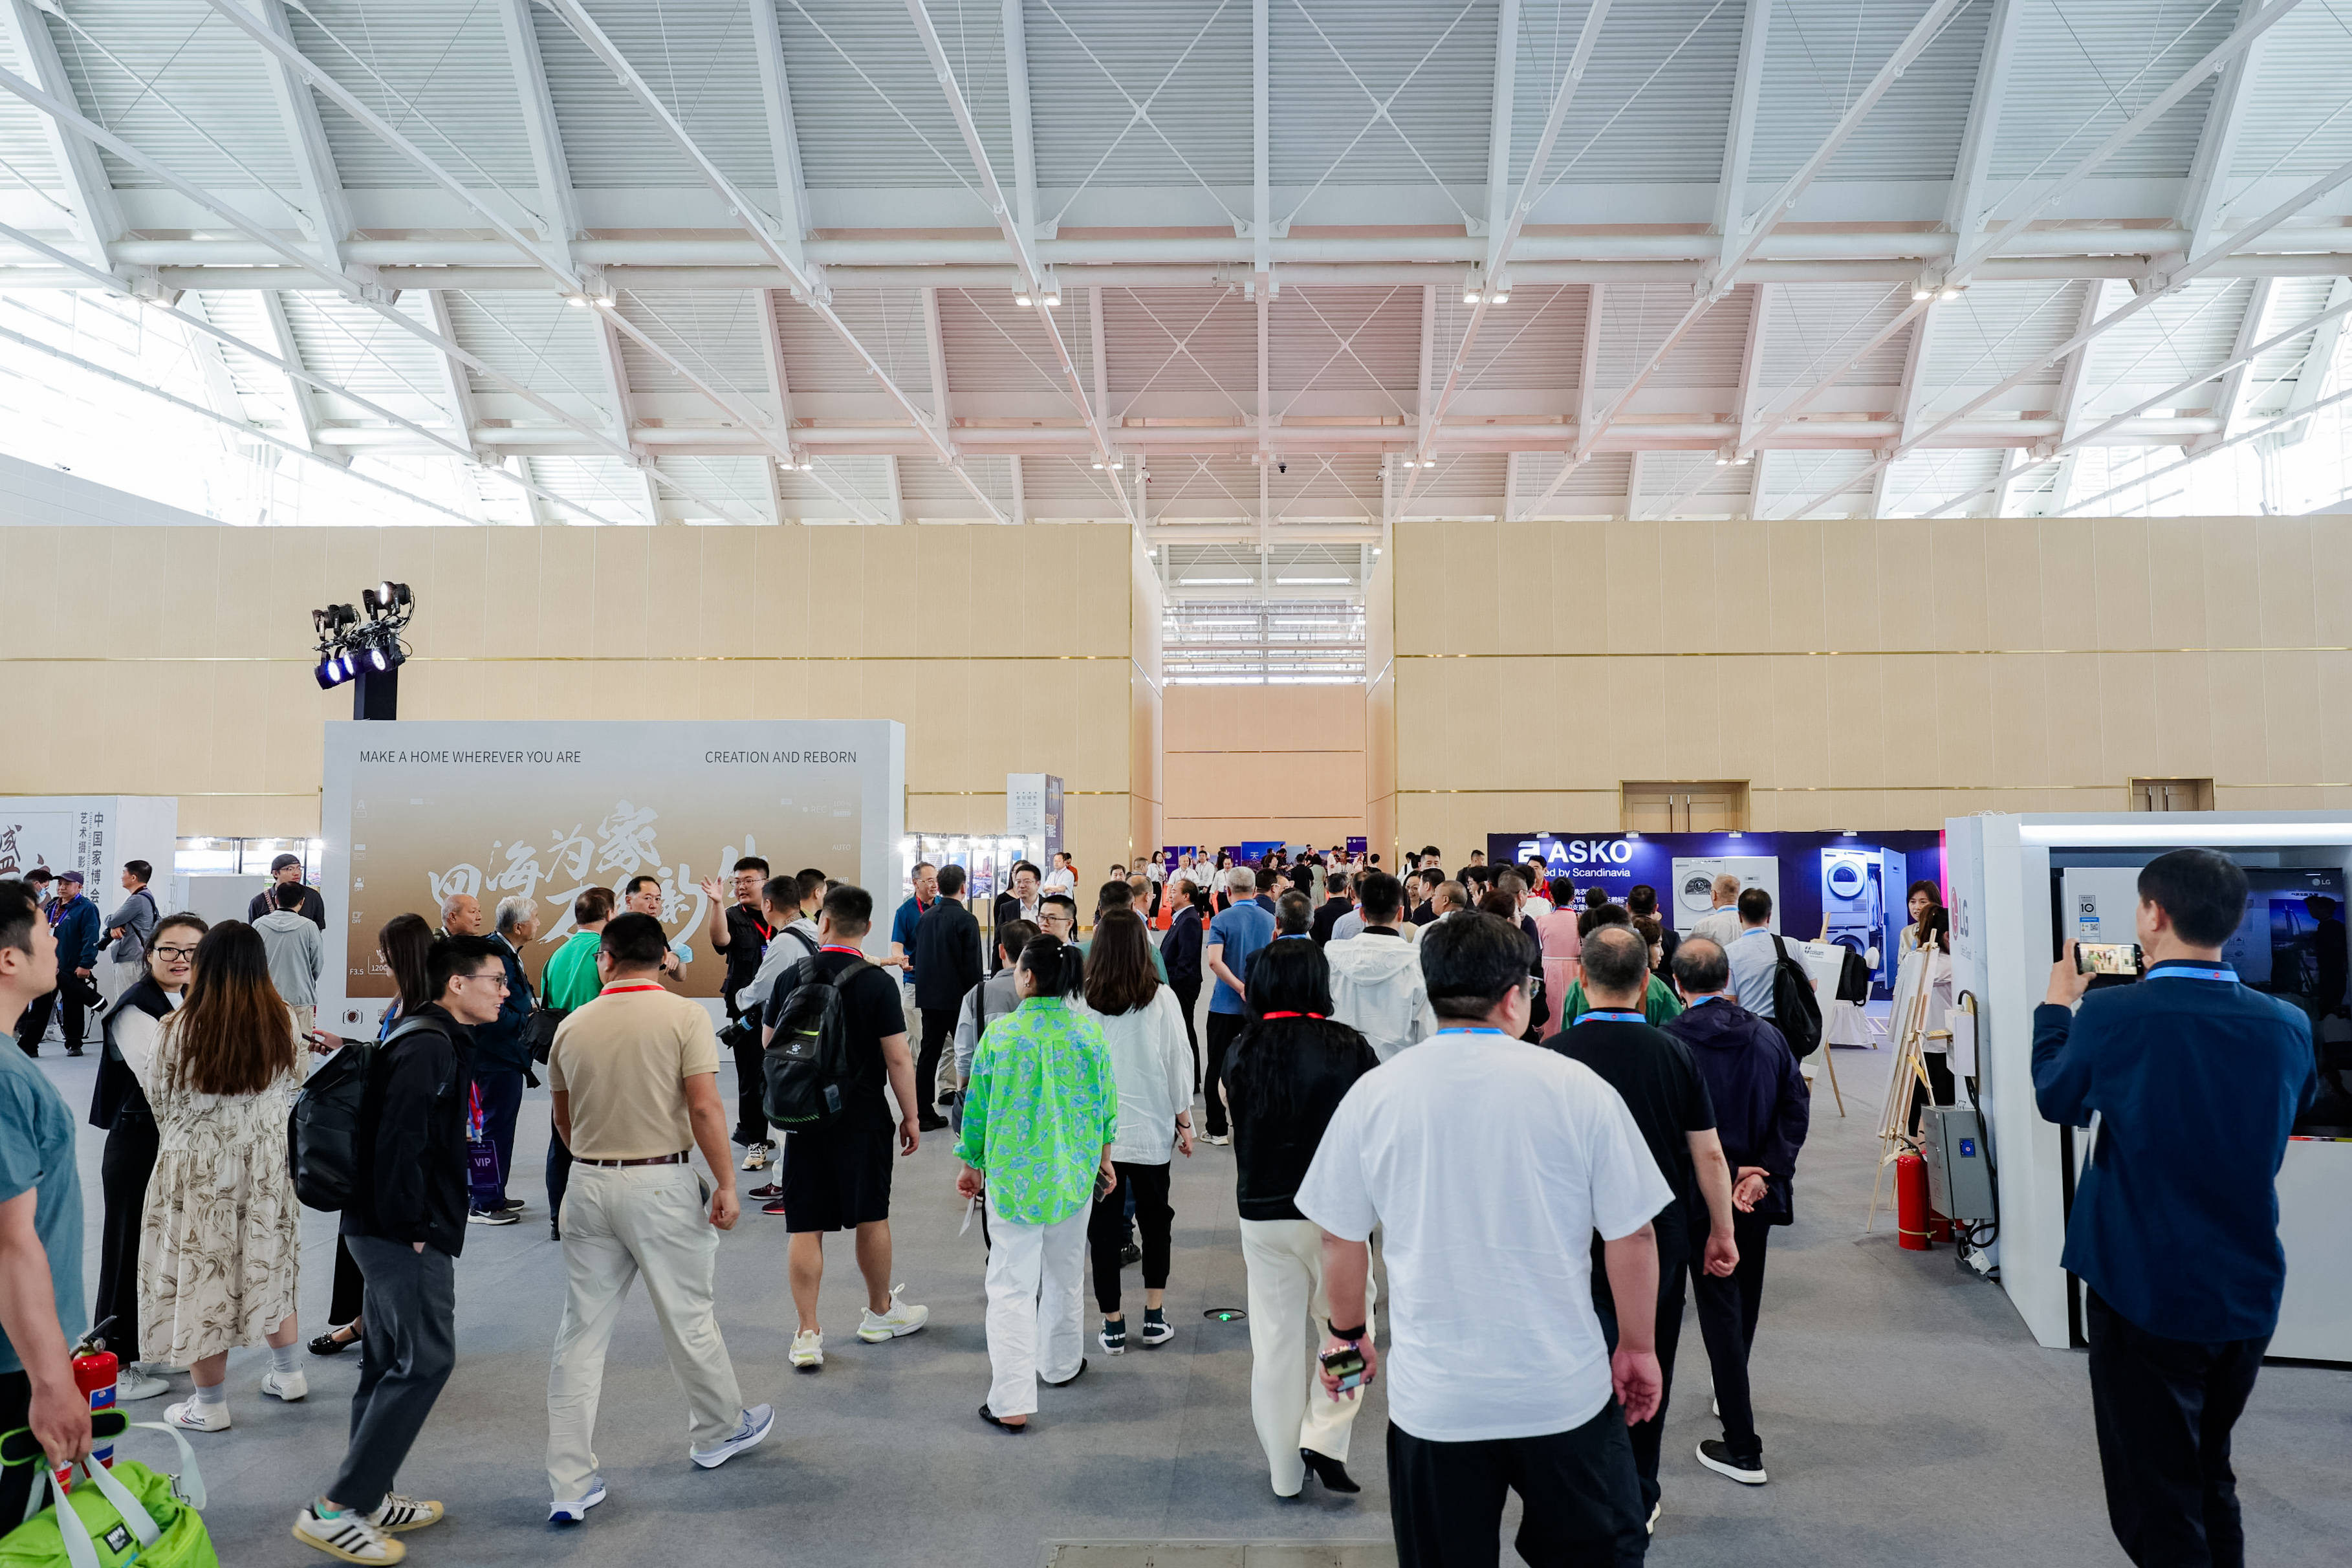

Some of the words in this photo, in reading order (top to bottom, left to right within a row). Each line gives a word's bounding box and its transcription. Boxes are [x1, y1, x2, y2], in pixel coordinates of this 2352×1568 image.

[360, 750, 396, 763] MAKE
[398, 750, 408, 763] A
[410, 750, 450, 763] HOME
[452, 750, 523, 763] WHEREVER
[527, 750, 553, 763] YOU
[556, 750, 582, 763] ARE
[705, 750, 769, 763] CREATION
[772, 750, 800, 763] AND
[803, 750, 856, 763] REBORN
[91, 812, 103, 904] 中国家博会
[1547, 840, 1633, 864] ASKO
[1558, 868, 1571, 878] by
[1573, 867, 1631, 877] Scandinavia
[2081, 903, 2095, 913] 10
[1959, 897, 1969, 937] LG
[475, 1157, 491, 1167] VIP
